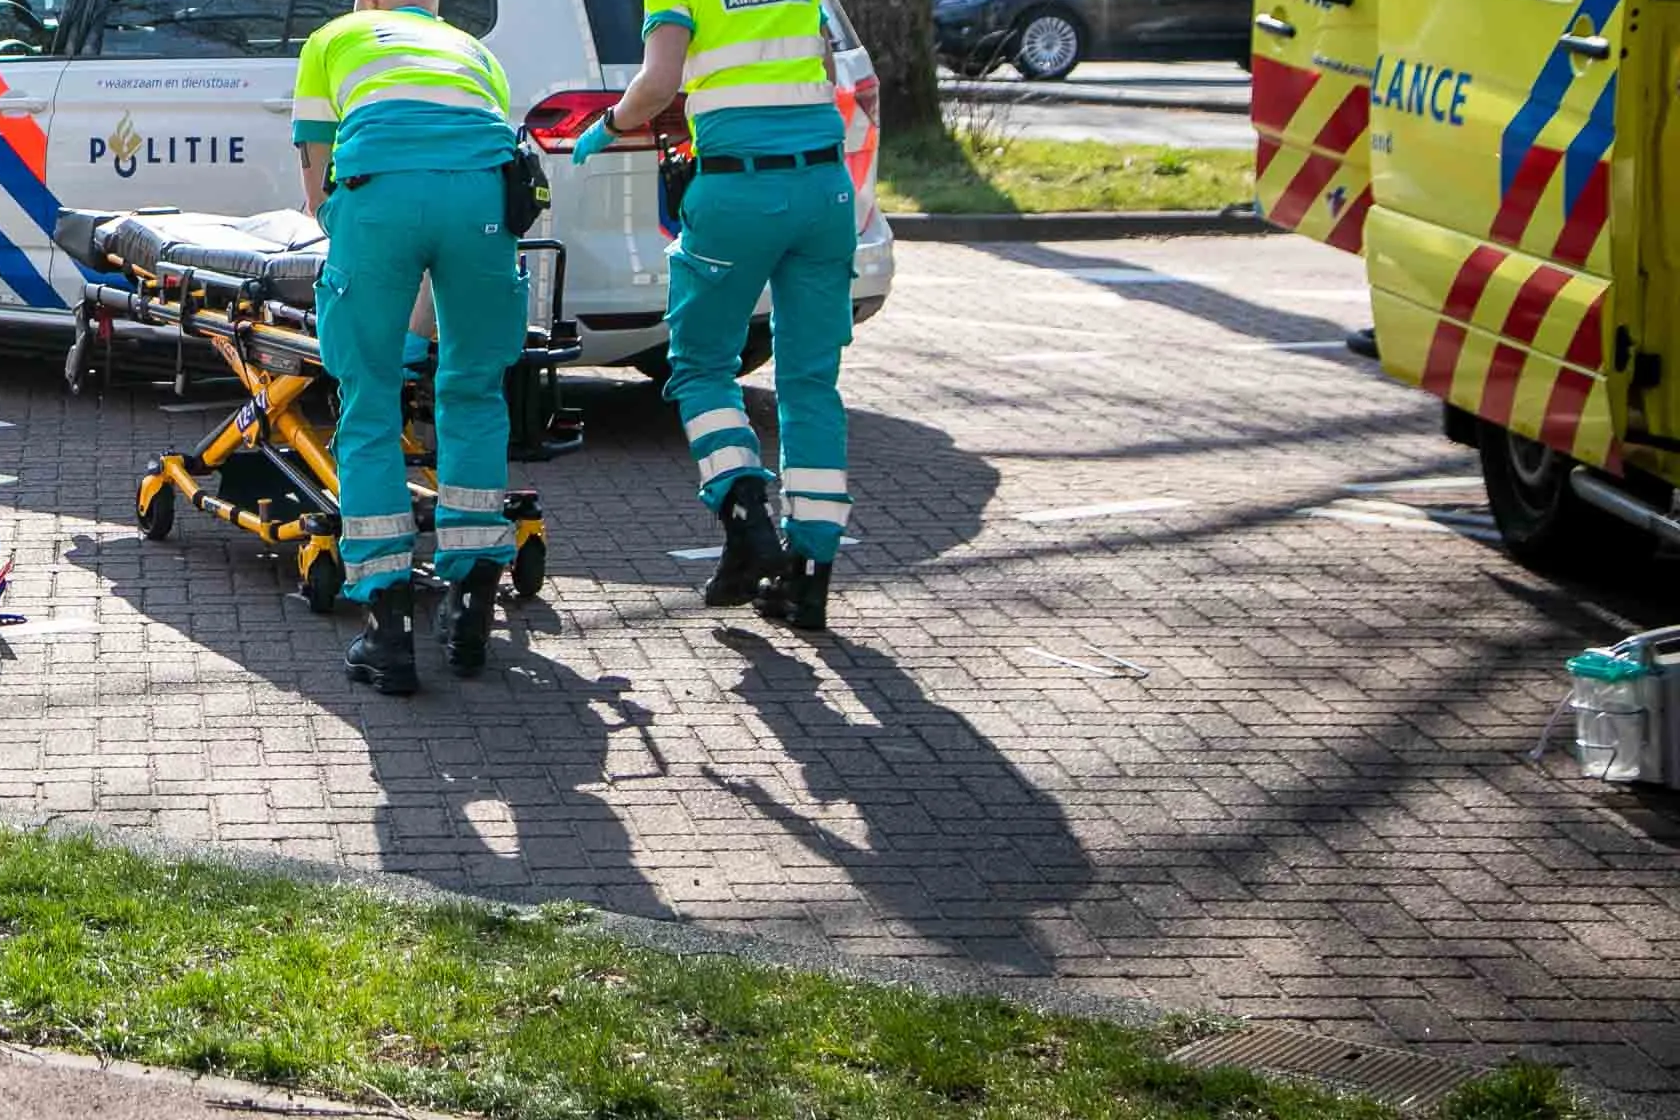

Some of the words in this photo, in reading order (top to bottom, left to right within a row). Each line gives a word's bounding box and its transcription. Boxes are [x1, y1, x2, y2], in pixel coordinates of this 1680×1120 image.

[165, 79, 179, 89] en
[182, 77, 240, 89] dienstbaar
[1372, 54, 1472, 126] LANCE
[89, 137, 245, 179] POLITIE
